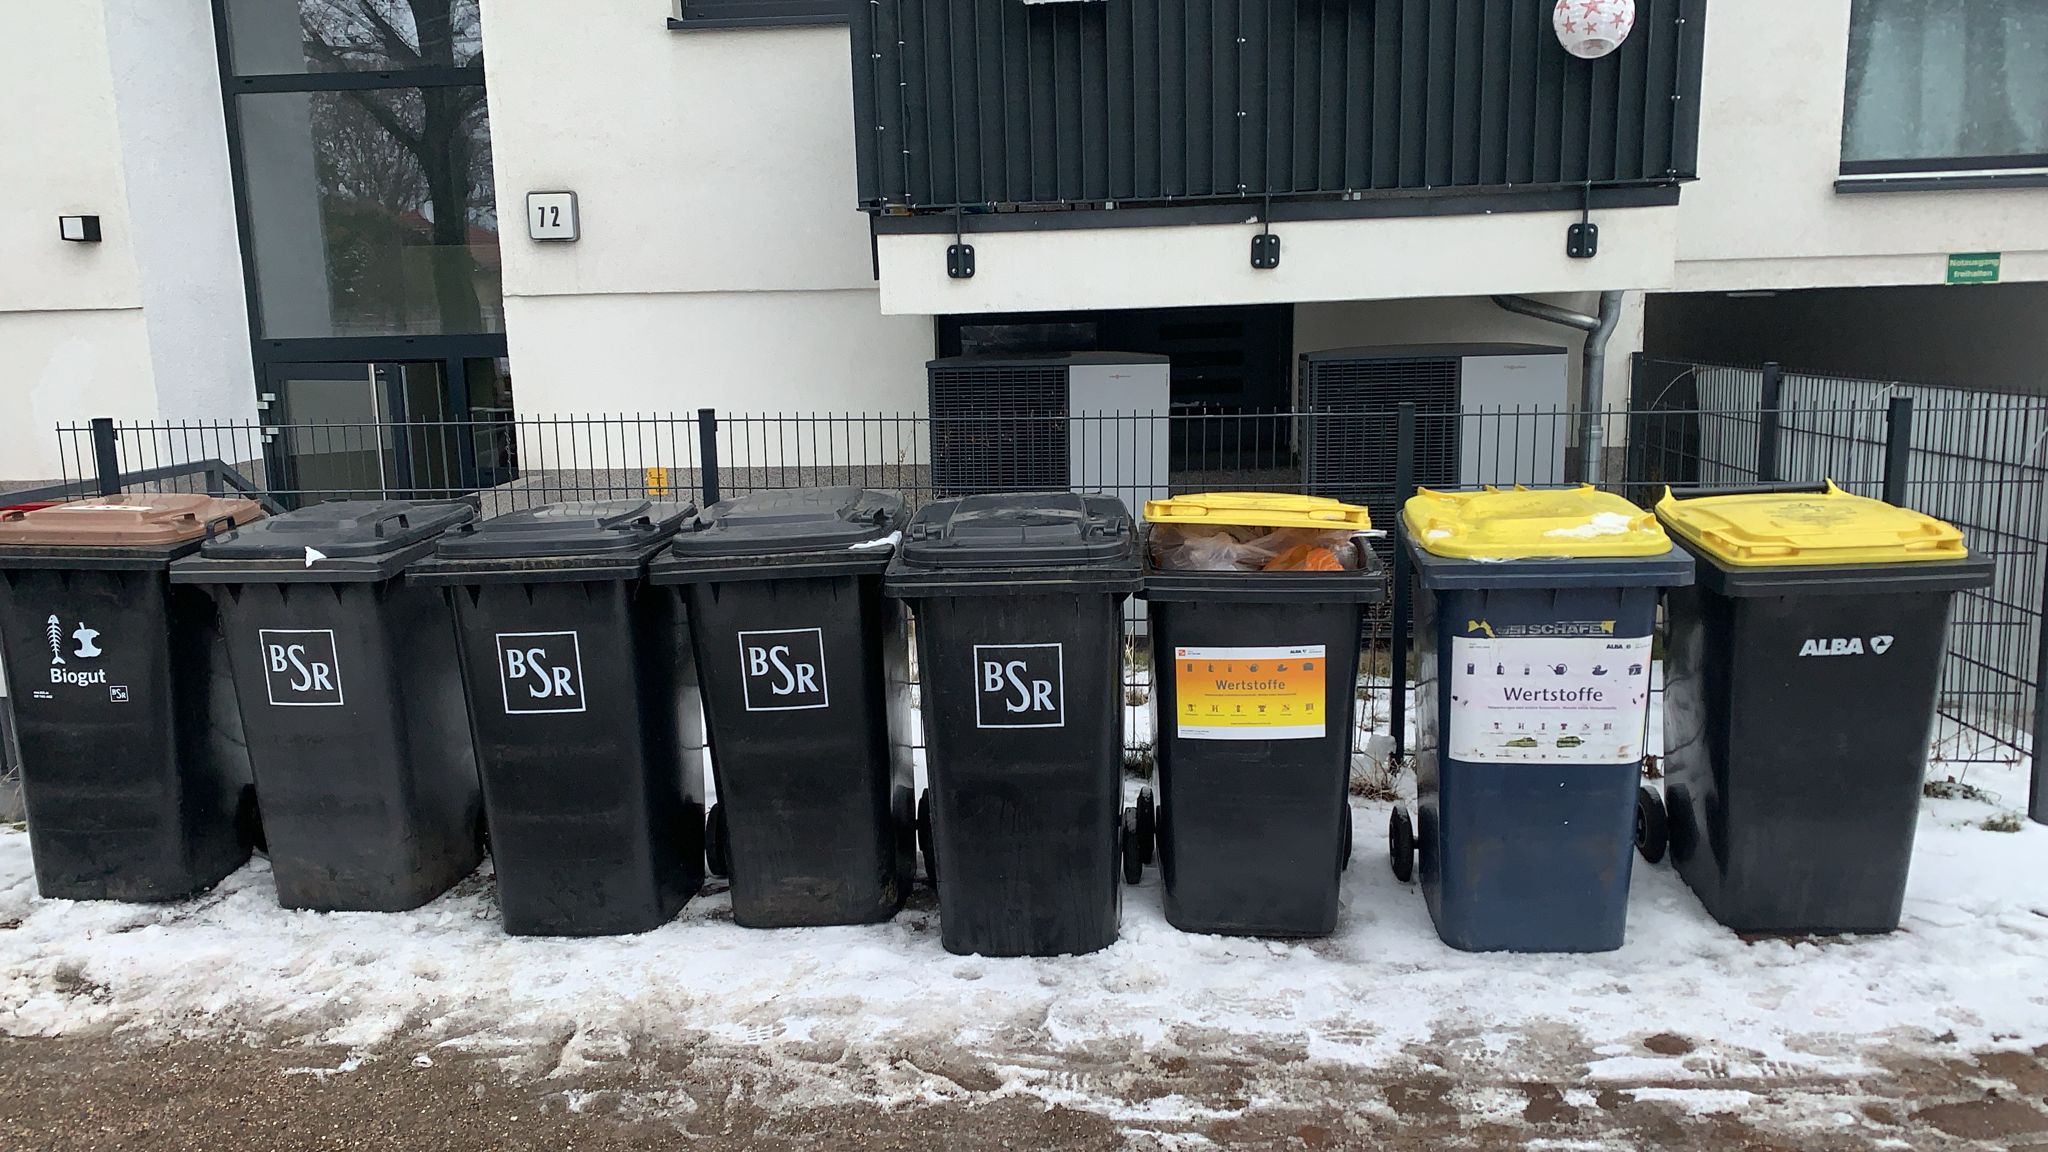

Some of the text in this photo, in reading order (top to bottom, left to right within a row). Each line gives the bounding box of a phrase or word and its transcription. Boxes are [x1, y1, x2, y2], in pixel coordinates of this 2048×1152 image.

[538, 206, 560, 228] 72
[1799, 637, 1864, 656] ALBA
[50, 668, 107, 687] Biogut
[268, 644, 334, 692] BSR
[505, 648, 577, 699] BSR
[748, 645, 820, 696] BSR
[982, 660, 1057, 713] BSR
[1215, 679, 1286, 690] Wertstoffe
[1503, 687, 1603, 702] Wertstoffe
